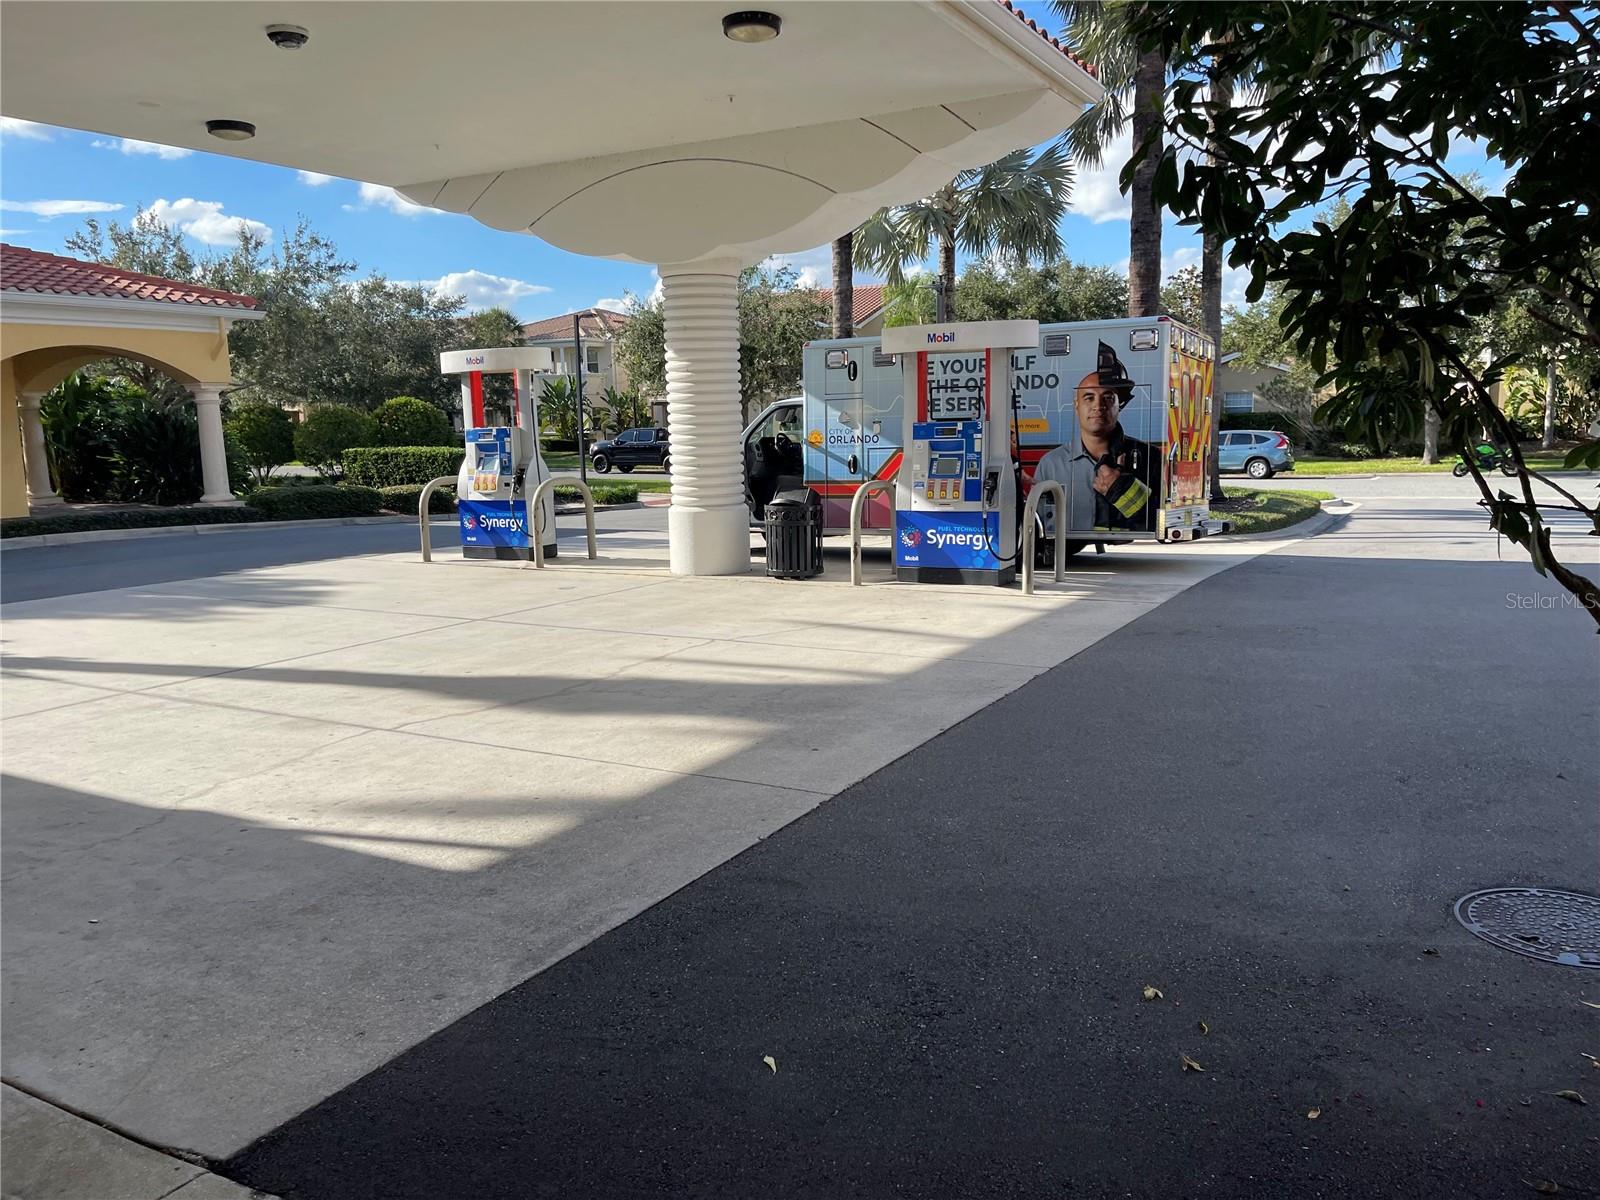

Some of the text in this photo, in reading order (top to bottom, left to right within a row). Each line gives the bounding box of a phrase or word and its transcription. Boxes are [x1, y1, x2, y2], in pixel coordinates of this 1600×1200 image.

[927, 332, 955, 343] Mobil
[465, 356, 485, 365] Mobil
[829, 435, 879, 444] ORLANDO
[480, 515, 523, 531] Synergy
[926, 529, 993, 550] Synergy
